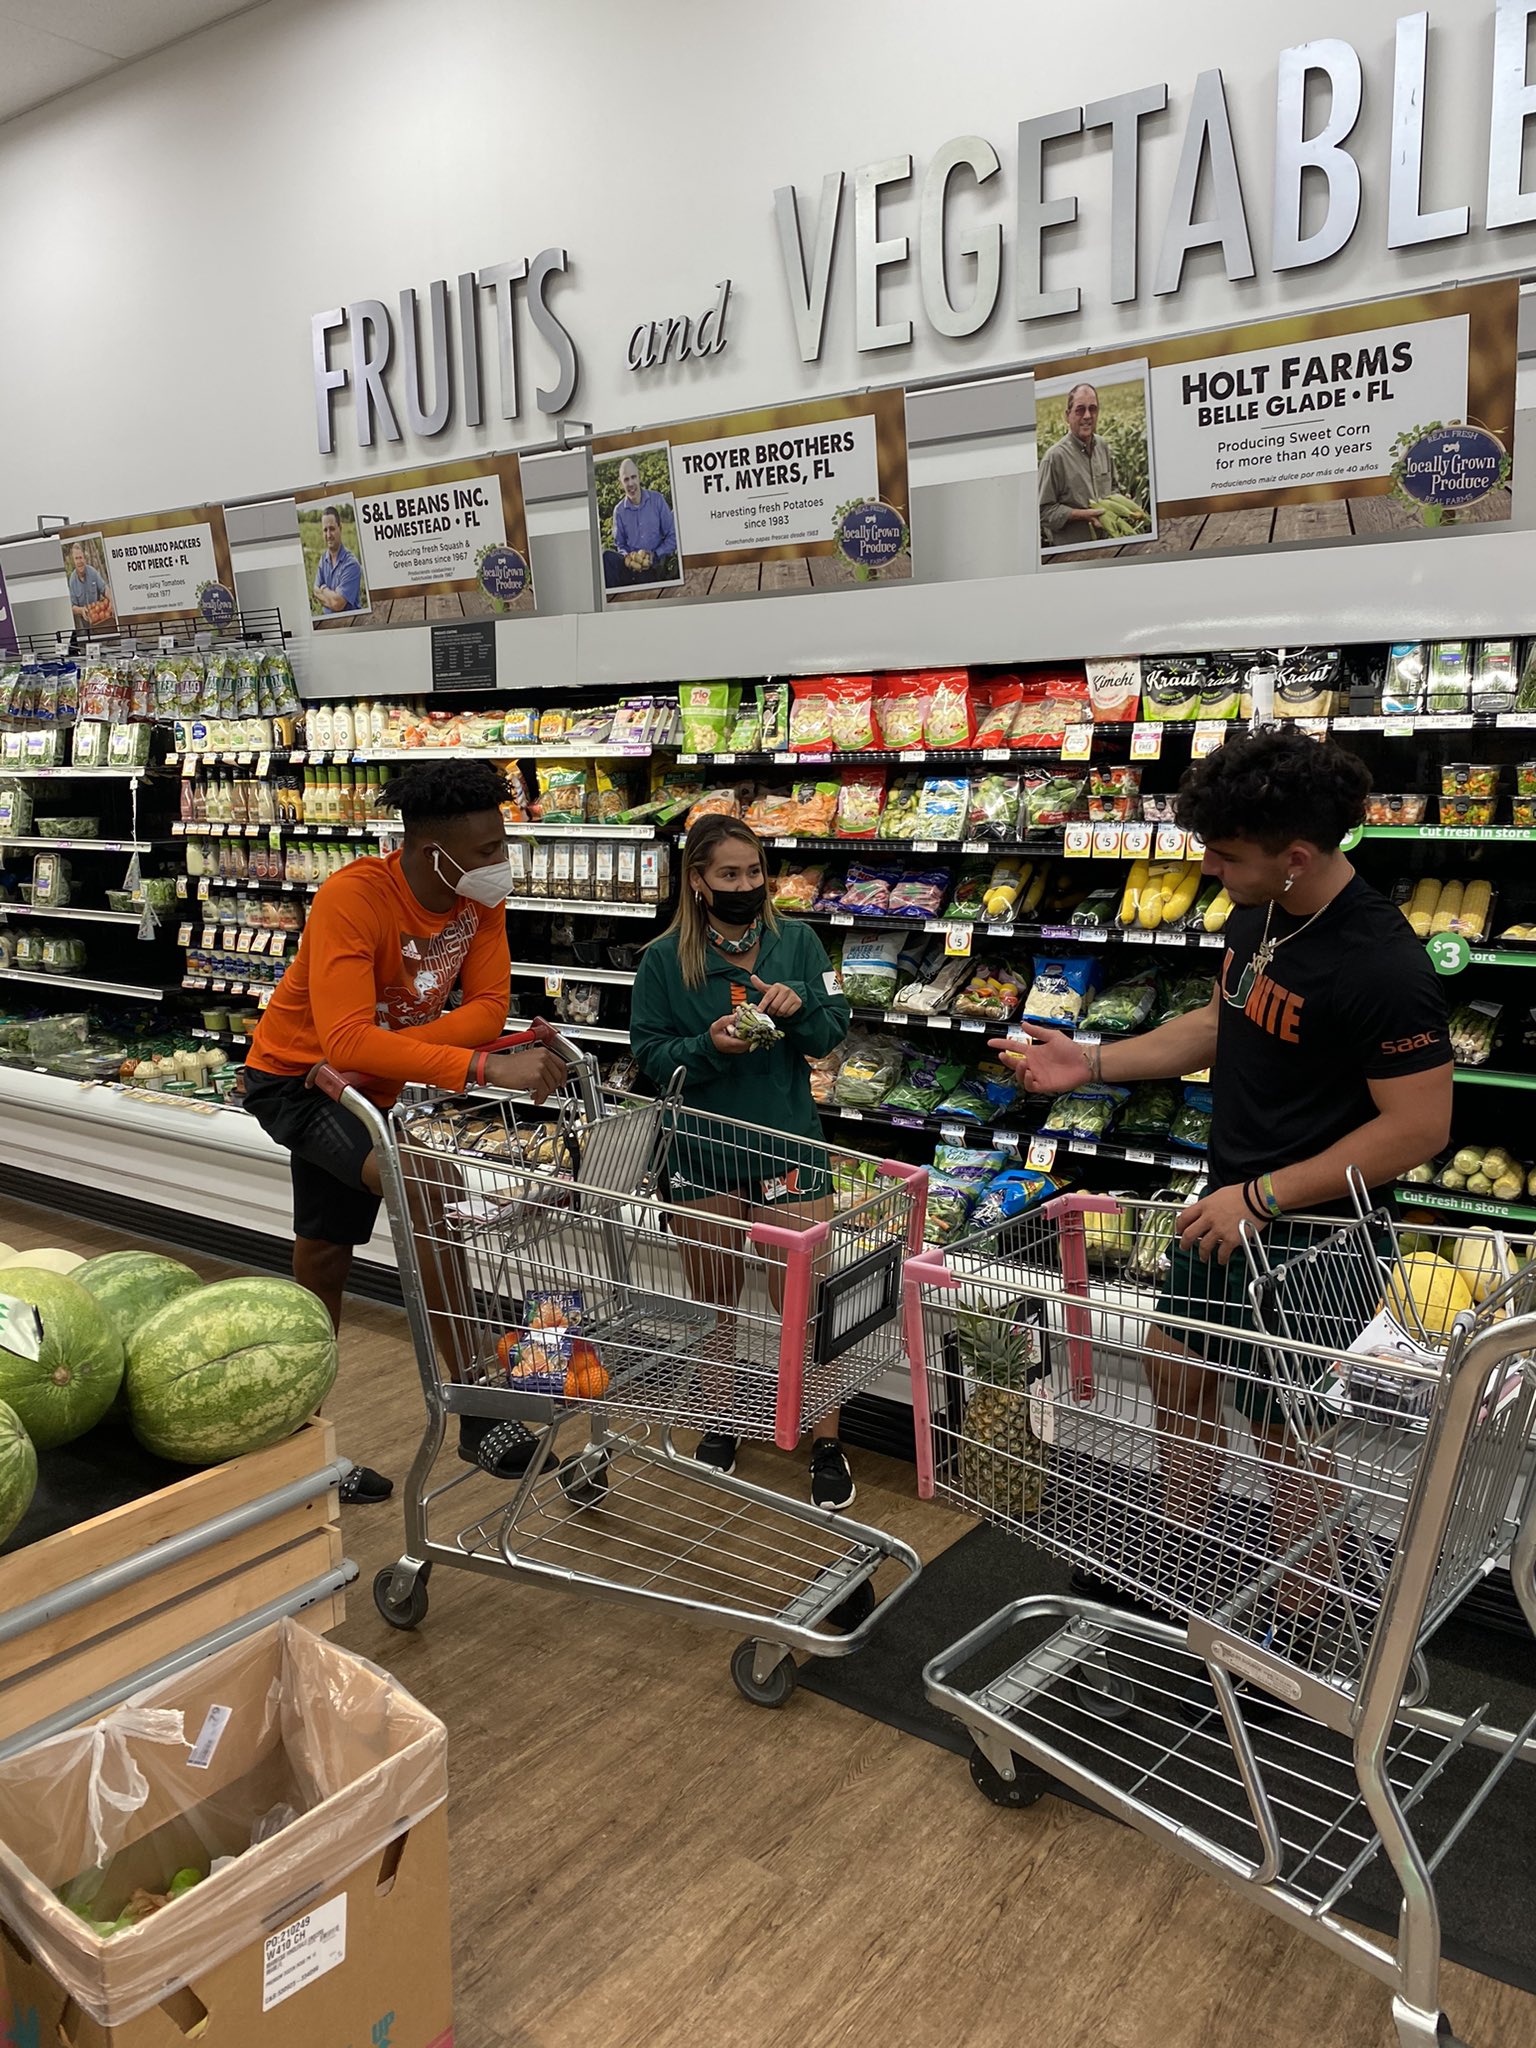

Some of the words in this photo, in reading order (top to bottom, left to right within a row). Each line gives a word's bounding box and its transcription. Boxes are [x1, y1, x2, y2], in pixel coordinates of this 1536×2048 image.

[310, 247, 578, 455] FRUITS
[625, 278, 733, 372] and
[1182, 364, 1270, 405] HOLT
[1281, 341, 1413, 390] FARMS
[1197, 401, 1259, 427] BELLE
[1266, 388, 1346, 417] GLADE
[1367, 379, 1394, 403] FL
[1217, 434, 1285, 453] Producing
[1289, 427, 1332, 444] Sweet
[1336, 422, 1371, 437] Corn
[1427, 431, 1450, 443] REAL
[1451, 430, 1478, 441] FRESH
[682, 447, 751, 475] TROYER
[755, 431, 855, 465] BROTHERS
[1215, 457, 1235, 470] for
[1238, 455, 1273, 468] more
[1276, 448, 1307, 463] than
[1311, 445, 1330, 458] 40
[1334, 441, 1373, 457] years
[1406, 455, 1450, 478] Locally
[1451, 453, 1496, 475] Grown
[703, 474, 730, 494] FT.
[735, 462, 808, 490] MYERS,
[813, 458, 835, 480] FL
[1210, 477, 1257, 490] Produciendo
[1278, 472, 1299, 483] dulce
[1300, 471, 1315, 480] por
[1333, 466, 1345, 475] de
[1346, 464, 1358, 473] 40
[1359, 463, 1379, 472] años
[1431, 473, 1489, 495] Produce
[362, 501, 394, 525] S&L
[396, 492, 450, 519] BEANS
[453, 487, 489, 510] INC.
[1424, 495, 1445, 505] REAL
[1445, 493, 1474, 505] FARMS
[710, 505, 757, 520] Harvesting
[758, 502, 781, 514] fresh
[783, 498, 824, 512] Potatoes
[374, 516, 451, 541] HOMESTEAD
[465, 510, 480, 528] FL
[744, 517, 767, 530] since
[768, 514, 790, 526] 1983
[843, 524, 871, 543] Locally
[871, 524, 900, 542] Grown
[111, 548, 124, 559] BIG
[125, 546, 138, 557] RED
[138, 542, 169, 556] TOMATO
[169, 537, 201, 550] PACKERS
[388, 545, 421, 558] Producing
[422, 543, 439, 554] fresh
[440, 540, 464, 552] Squash
[465, 539, 471, 548] &
[860, 538, 897, 556] Produce
[127, 560, 146, 572] FORT
[148, 556, 173, 570] PIERCE
[179, 555, 189, 566] FL
[393, 559, 412, 569] Green
[413, 556, 433, 567] Beans
[434, 554, 451, 564] since
[452, 551, 468, 562] 1967
[483, 564, 503, 581] Locally
[503, 564, 525, 580] Grown
[129, 583, 149, 592] Growing
[161, 579, 186, 587] Tomatoes
[495, 577, 523, 592] Produce
[1093, 672, 1135, 692] Kimchi
[1146, 669, 1202, 692] Kraut
[1277, 664, 1333, 688] Kraut
[1312, 718, 1327, 726] 5.99
[800, 753, 823, 762] Organic
[1074, 837, 1082, 847] $5
[1102, 837, 1111, 847] $5
[1132, 837, 1141, 847] $5
[1419, 826, 1444, 838] Cut
[1444, 826, 1479, 838] fresh
[1480, 827, 1493, 838] in
[1495, 828, 1531, 839] store
[1166, 837, 1175, 848] $5
[1041, 927, 1071, 938] Organic
[849, 944, 873, 953] WATER
[954, 937, 963, 948] $5
[1433, 939, 1461, 969] $3
[1381, 1030, 1441, 1055] saac
[892, 1116, 916, 1126] Organic
[1037, 1153, 1045, 1163] $5
[1139, 1151, 1152, 1159] 2.99
[1402, 1191, 1426, 1204] Cut
[1426, 1193, 1459, 1208] fresh
[1460, 1199, 1474, 1211] in
[1475, 1202, 1509, 1216] store
[265, 1916, 311, 1952] PO:210249
[266, 1939, 292, 1961] W410
[293, 1930, 306, 1945] CH
